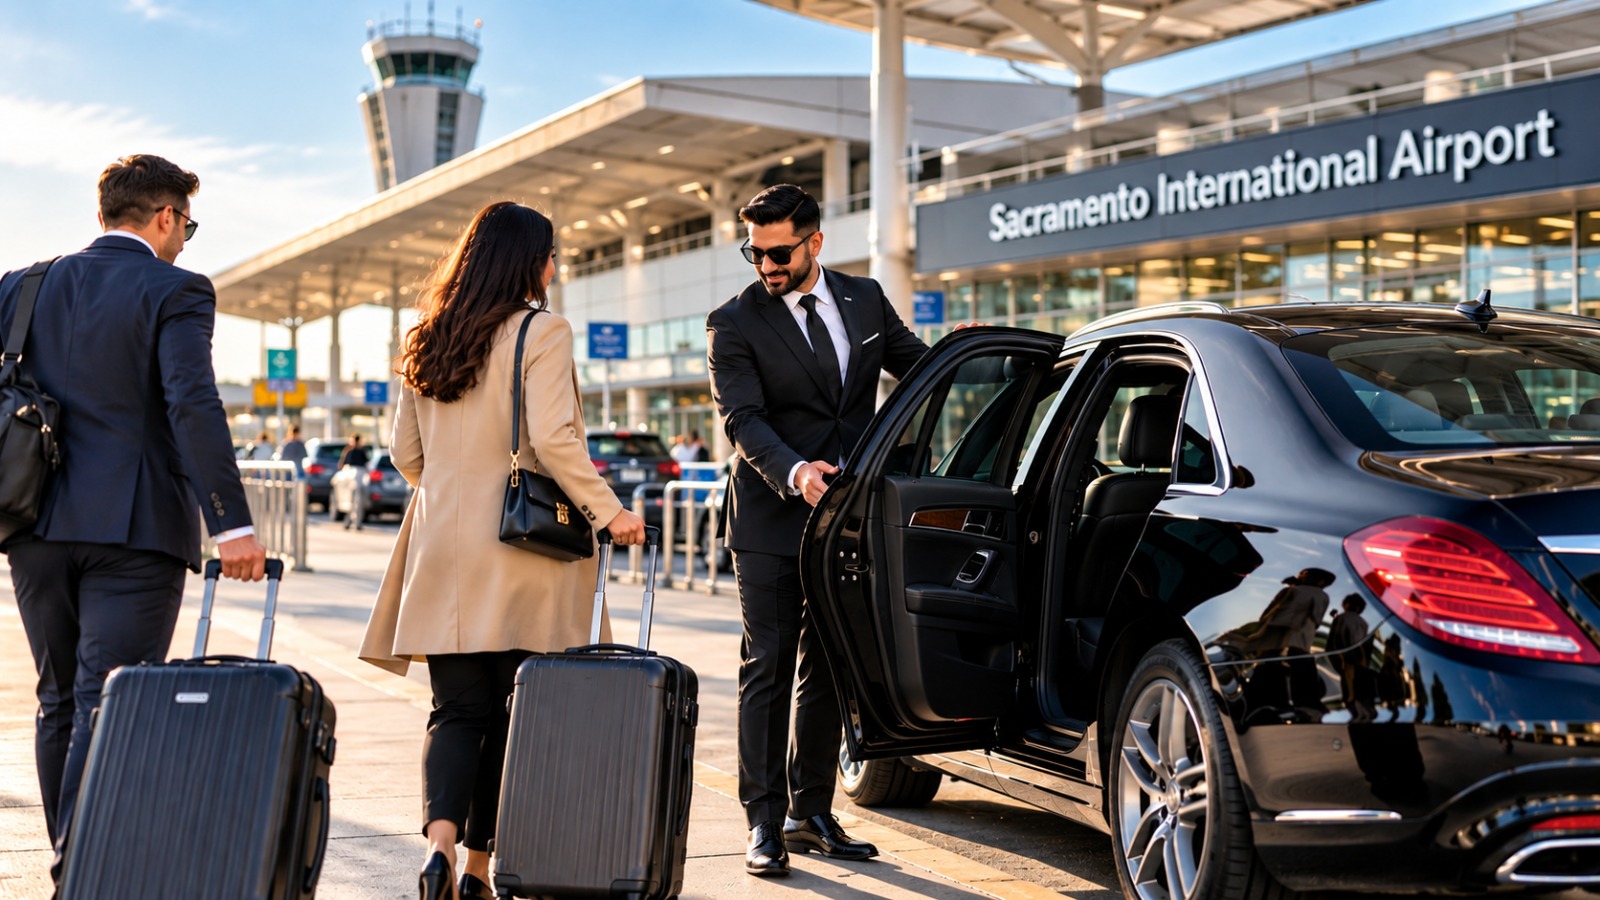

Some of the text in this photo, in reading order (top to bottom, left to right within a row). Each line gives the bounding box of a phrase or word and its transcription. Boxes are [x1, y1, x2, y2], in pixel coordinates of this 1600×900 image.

[989, 108, 1556, 242] Sacramento International Airport
